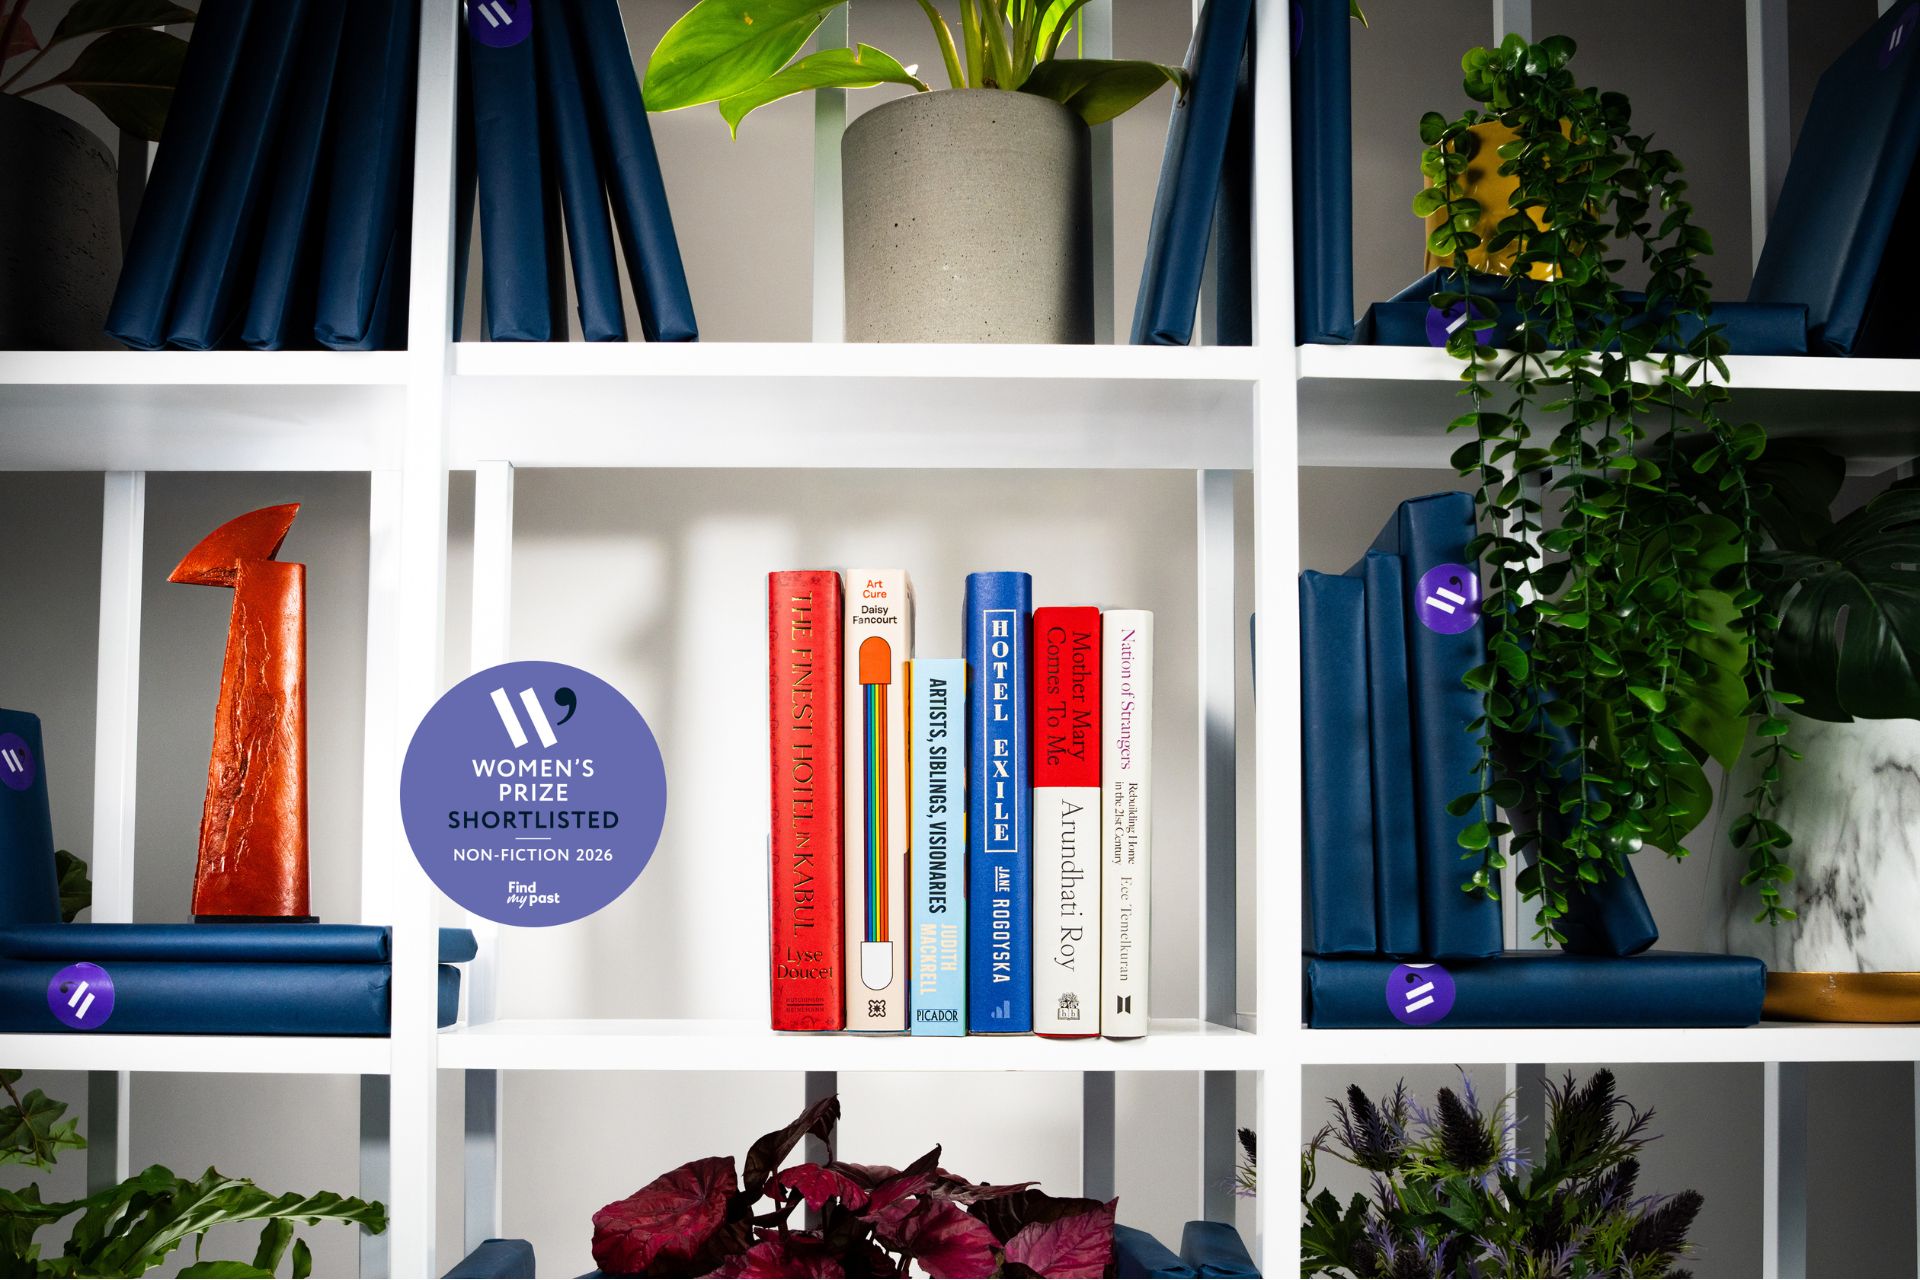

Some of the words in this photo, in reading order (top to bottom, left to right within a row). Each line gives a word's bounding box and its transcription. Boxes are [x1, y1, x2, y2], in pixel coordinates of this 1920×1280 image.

[862, 589, 888, 598] Cure
[866, 579, 883, 588] Art
[791, 592, 813, 641] THE
[852, 616, 898, 625] Fancourt
[861, 605, 889, 616] Daisy
[991, 620, 1009, 721] HOTEL
[1047, 626, 1066, 695] Comes
[1072, 631, 1092, 702] Mother
[1120, 629, 1136, 679] Nation
[791, 649, 814, 735] FINEST
[927, 678, 947, 742] ARTISTS,
[1120, 682, 1136, 698] of
[1047, 701, 1066, 728] To
[1067, 710, 1092, 761] Mary
[1116, 701, 1135, 770] Strangers
[1047, 734, 1067, 766] Me
[792, 744, 814, 828] HOTEL
[926, 746, 947, 818] SIBLINGS,
[992, 739, 1010, 841] EXILE
[1114, 781, 1125, 790] in
[1114, 792, 1125, 806] the
[1114, 808, 1125, 825] 21st
[1126, 783, 1138, 833] Rebuilding
[796, 831, 811, 848] IN
[1060, 798, 1084, 917] Arundhati
[1112, 827, 1124, 865] Century
[1128, 835, 1138, 864] Home
[928, 821, 947, 914] VISIONARIES
[997, 866, 1010, 892] JANE
[1120, 877, 1133, 900] Ece
[793, 853, 815, 938] KABUL
[787, 946, 823, 967] Lyse
[919, 923, 937, 995] MACKRELL
[940, 924, 957, 971] JUDITH
[992, 899, 1011, 983] ROGOYSKA
[1054, 925, 1083, 972] Roy
[1119, 904, 1132, 981] Temelkuran
[777, 964, 833, 979] Doucet
[916, 1009, 959, 1022] PICADOR
